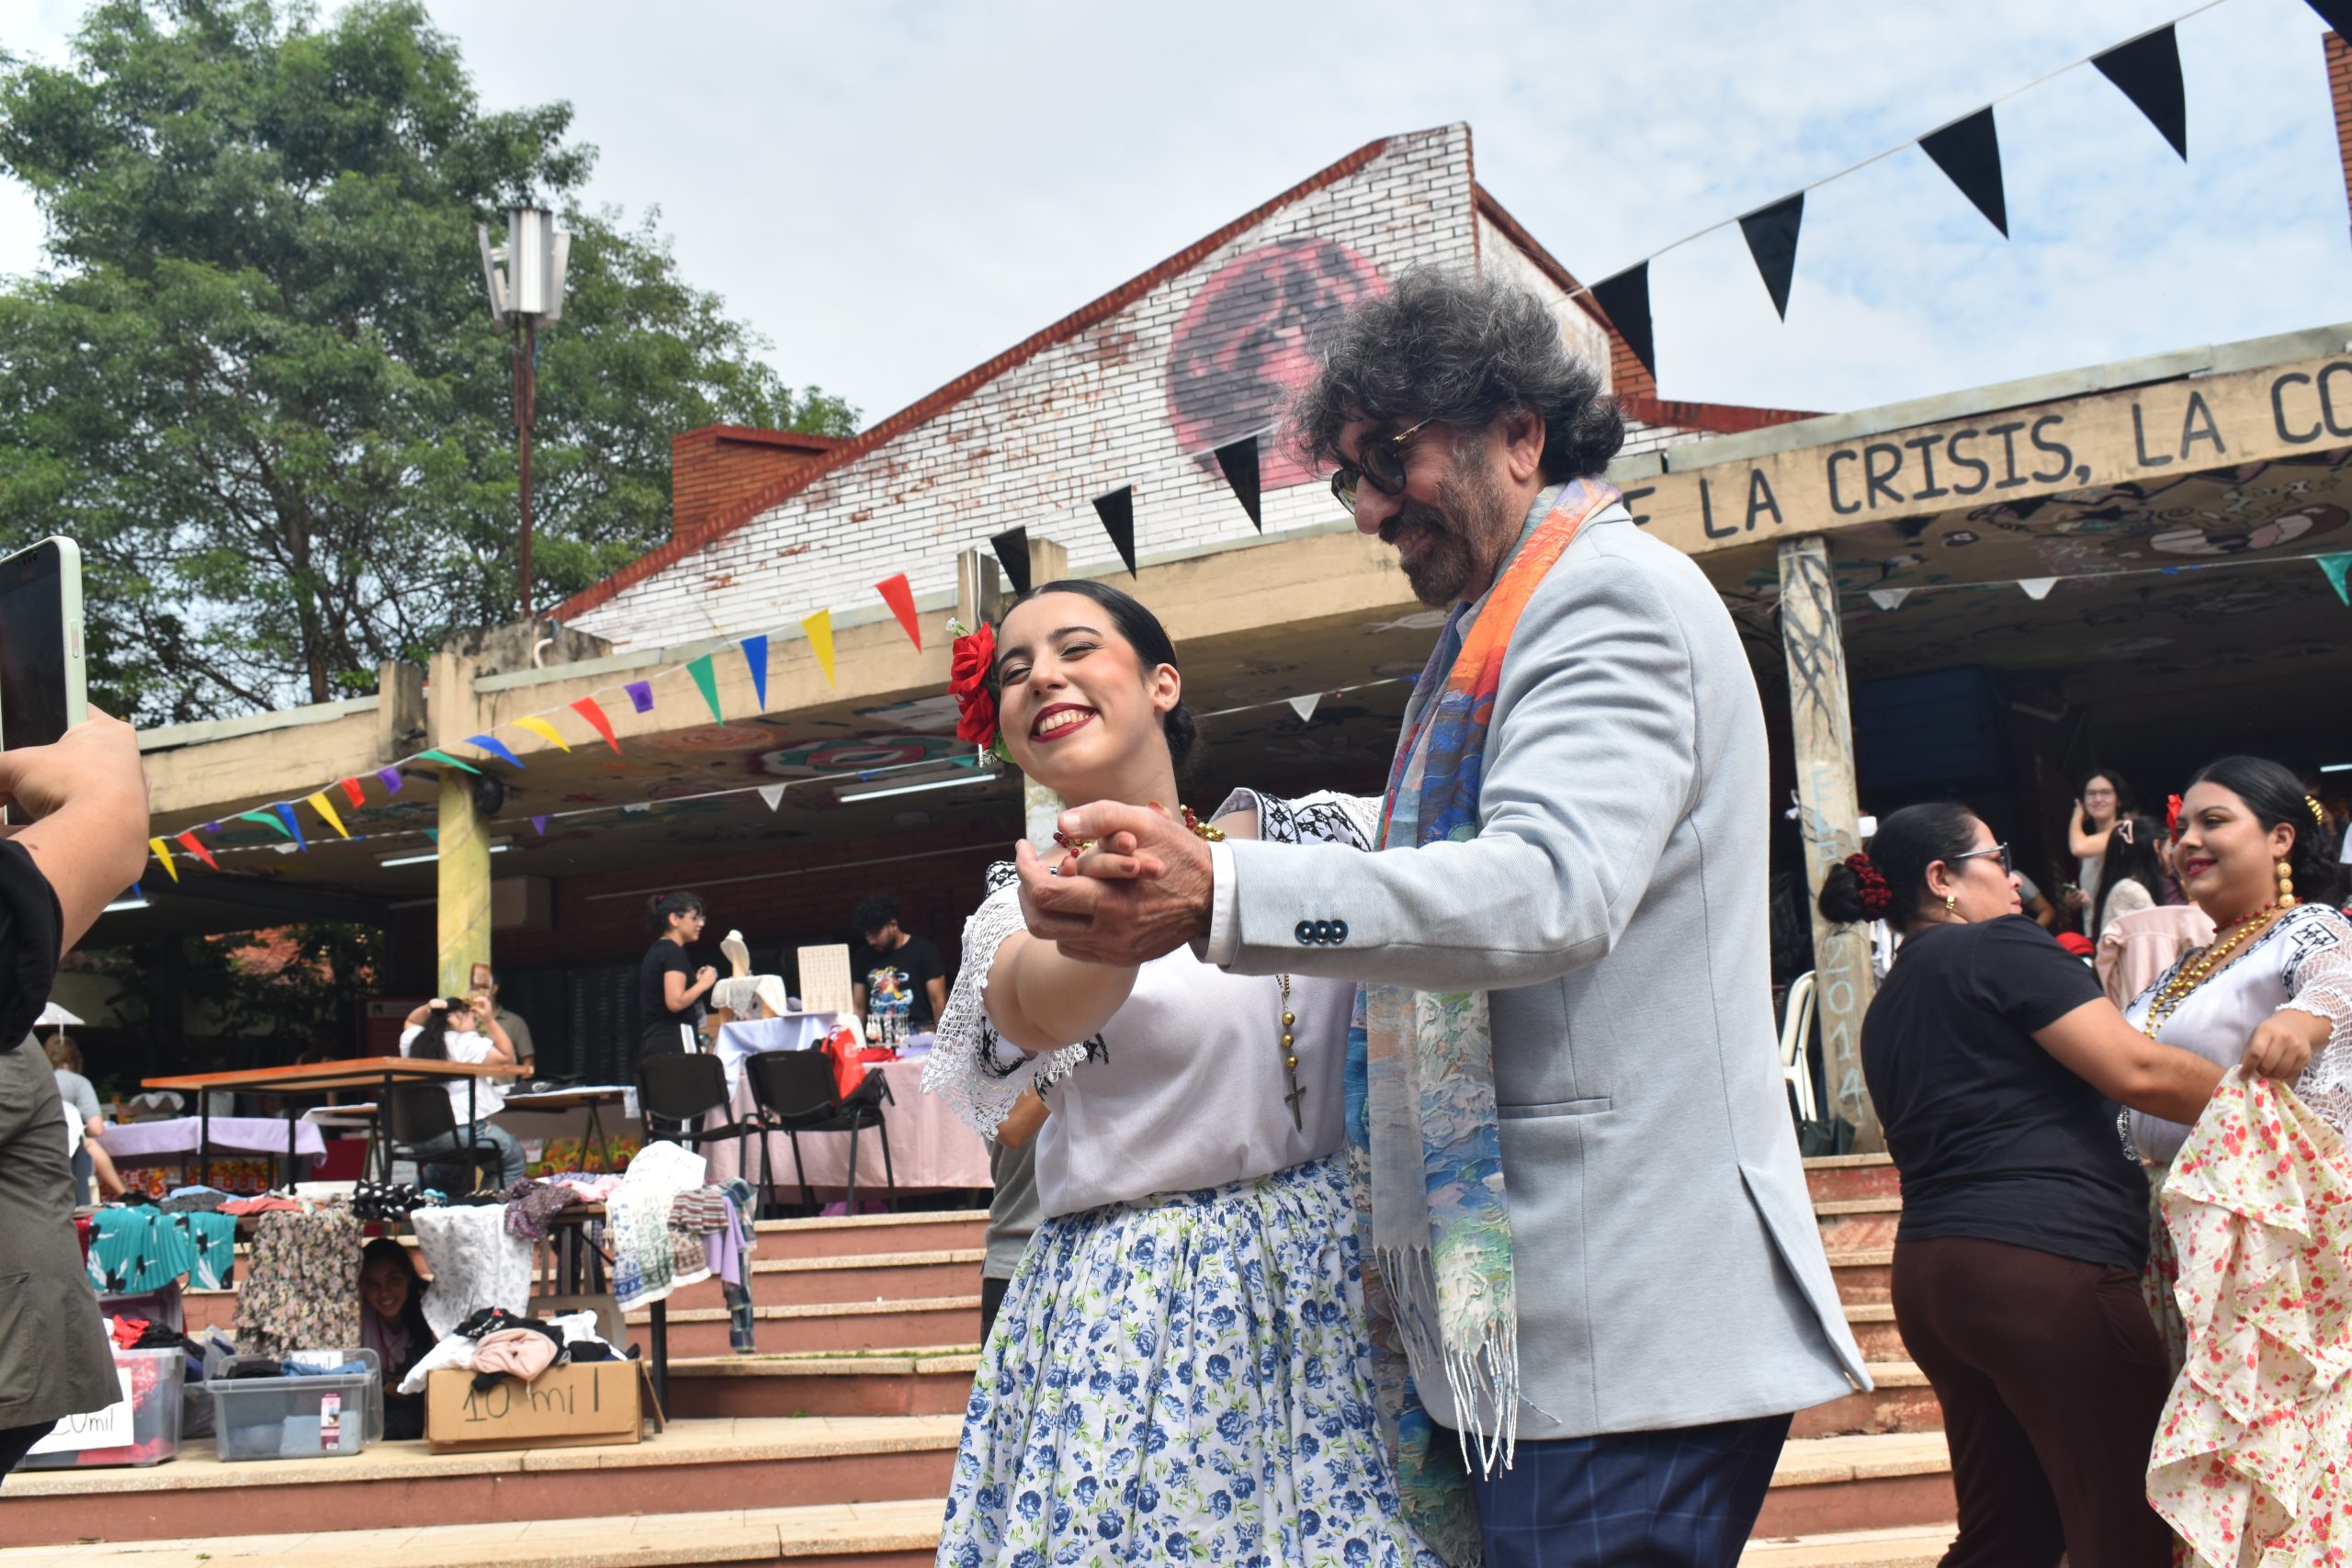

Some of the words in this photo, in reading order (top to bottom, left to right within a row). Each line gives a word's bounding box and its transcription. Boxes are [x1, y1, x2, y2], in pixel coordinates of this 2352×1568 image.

[1700, 468, 1782, 538] LA
[1826, 415, 2091, 514] CRISIS,
[2132, 390, 2226, 467] LA
[1825, 935, 1868, 1119] 2014
[462, 1383, 511, 1422] 10
